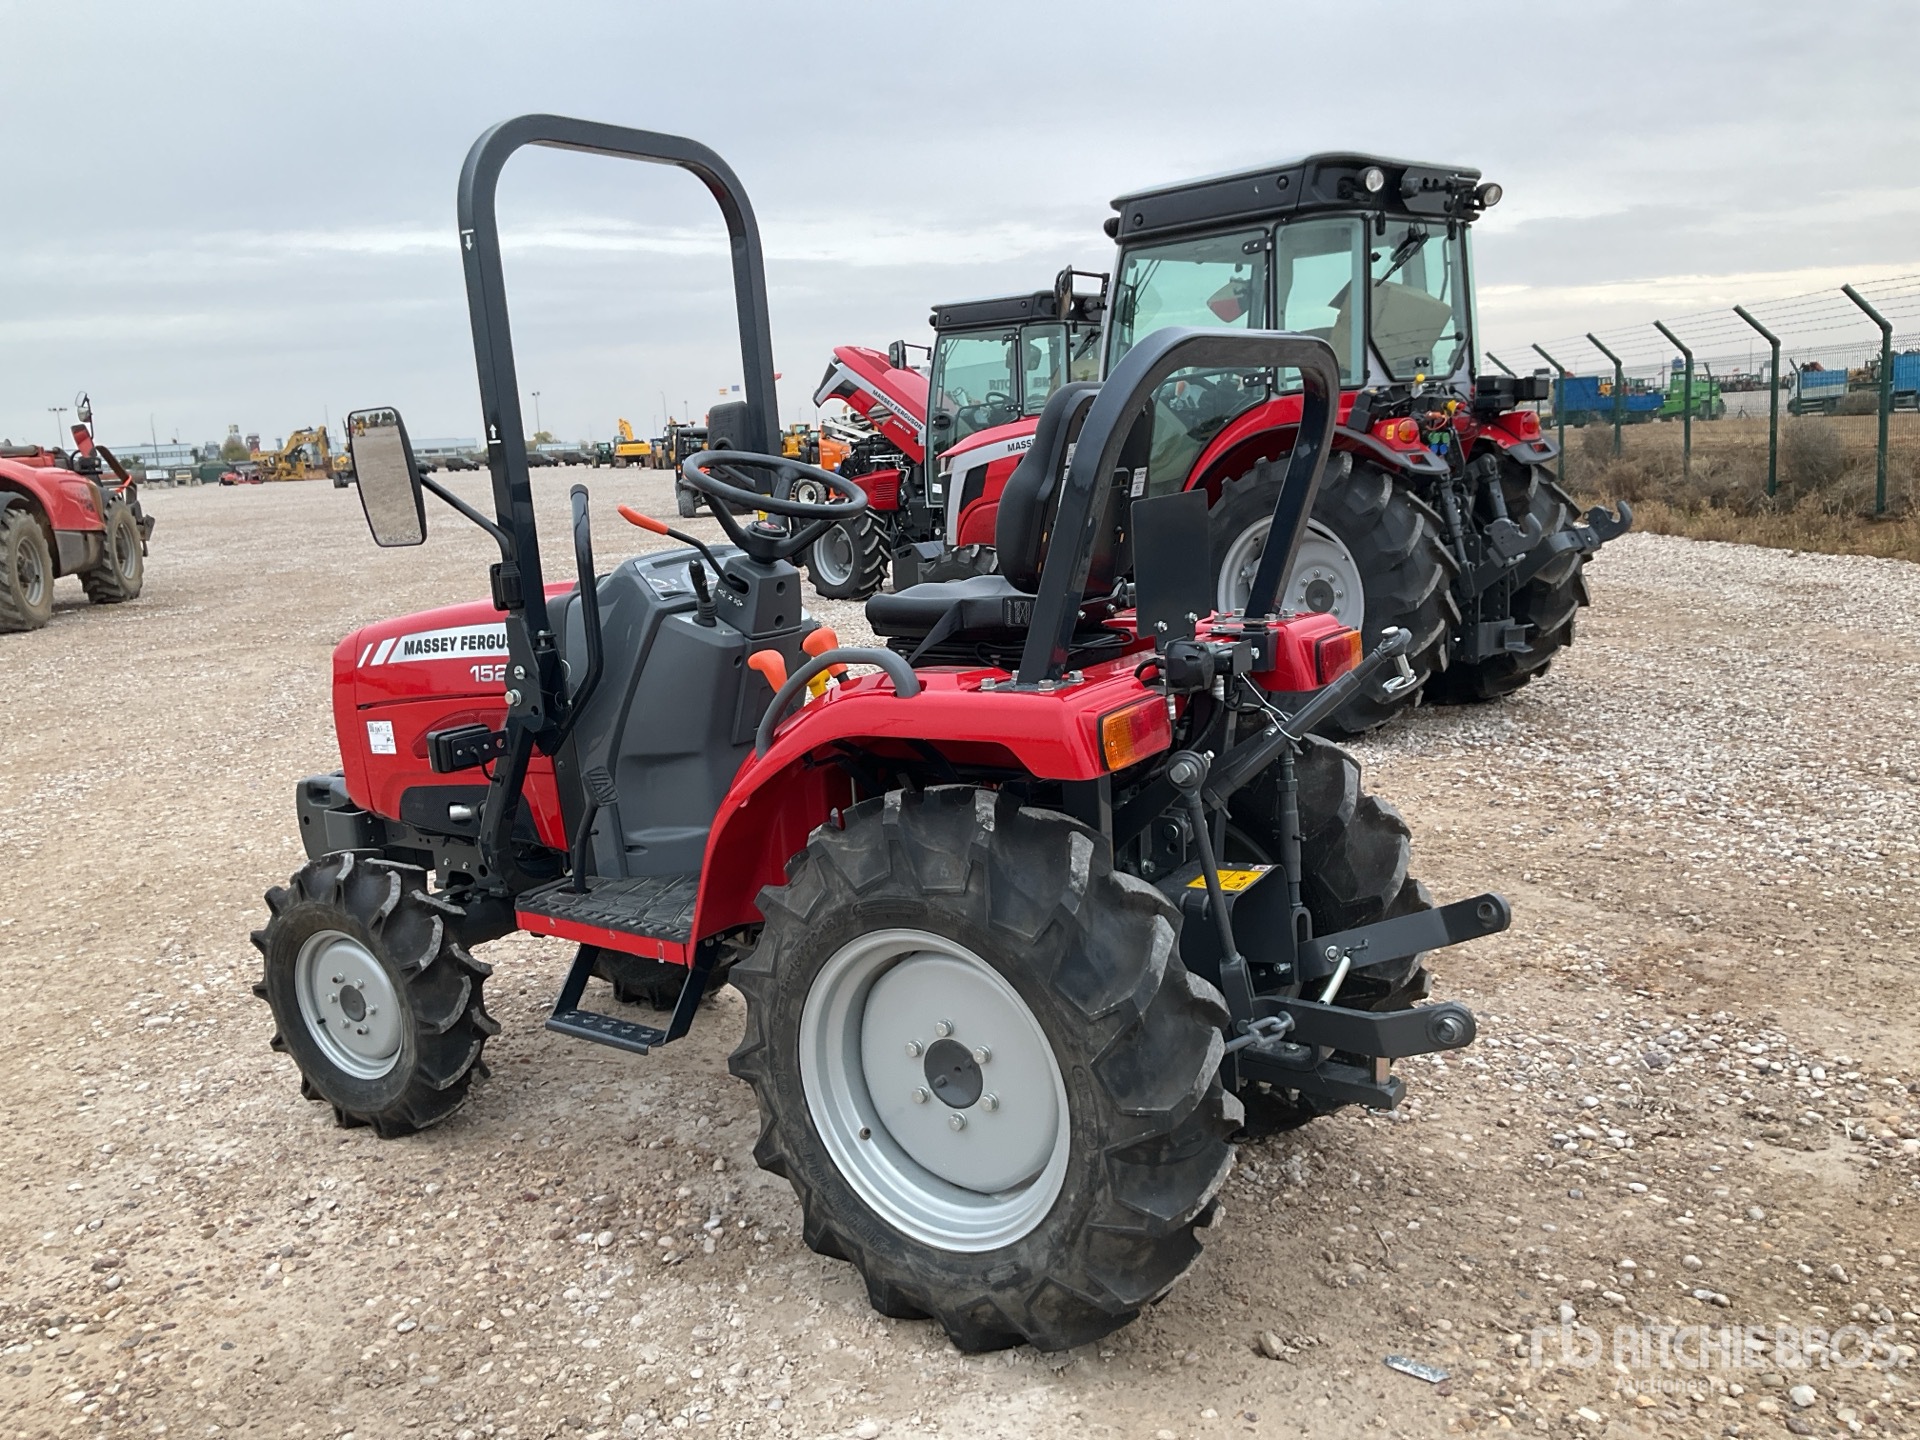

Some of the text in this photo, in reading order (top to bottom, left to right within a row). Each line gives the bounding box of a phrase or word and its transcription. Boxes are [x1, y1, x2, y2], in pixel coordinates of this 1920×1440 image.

[872, 389, 895, 409] MASSEY
[893, 405, 924, 431] FERGUSON
[1007, 438, 1036, 452] MASS
[404, 633, 508, 656] MASSEY FERGU
[469, 663, 508, 683] 152
